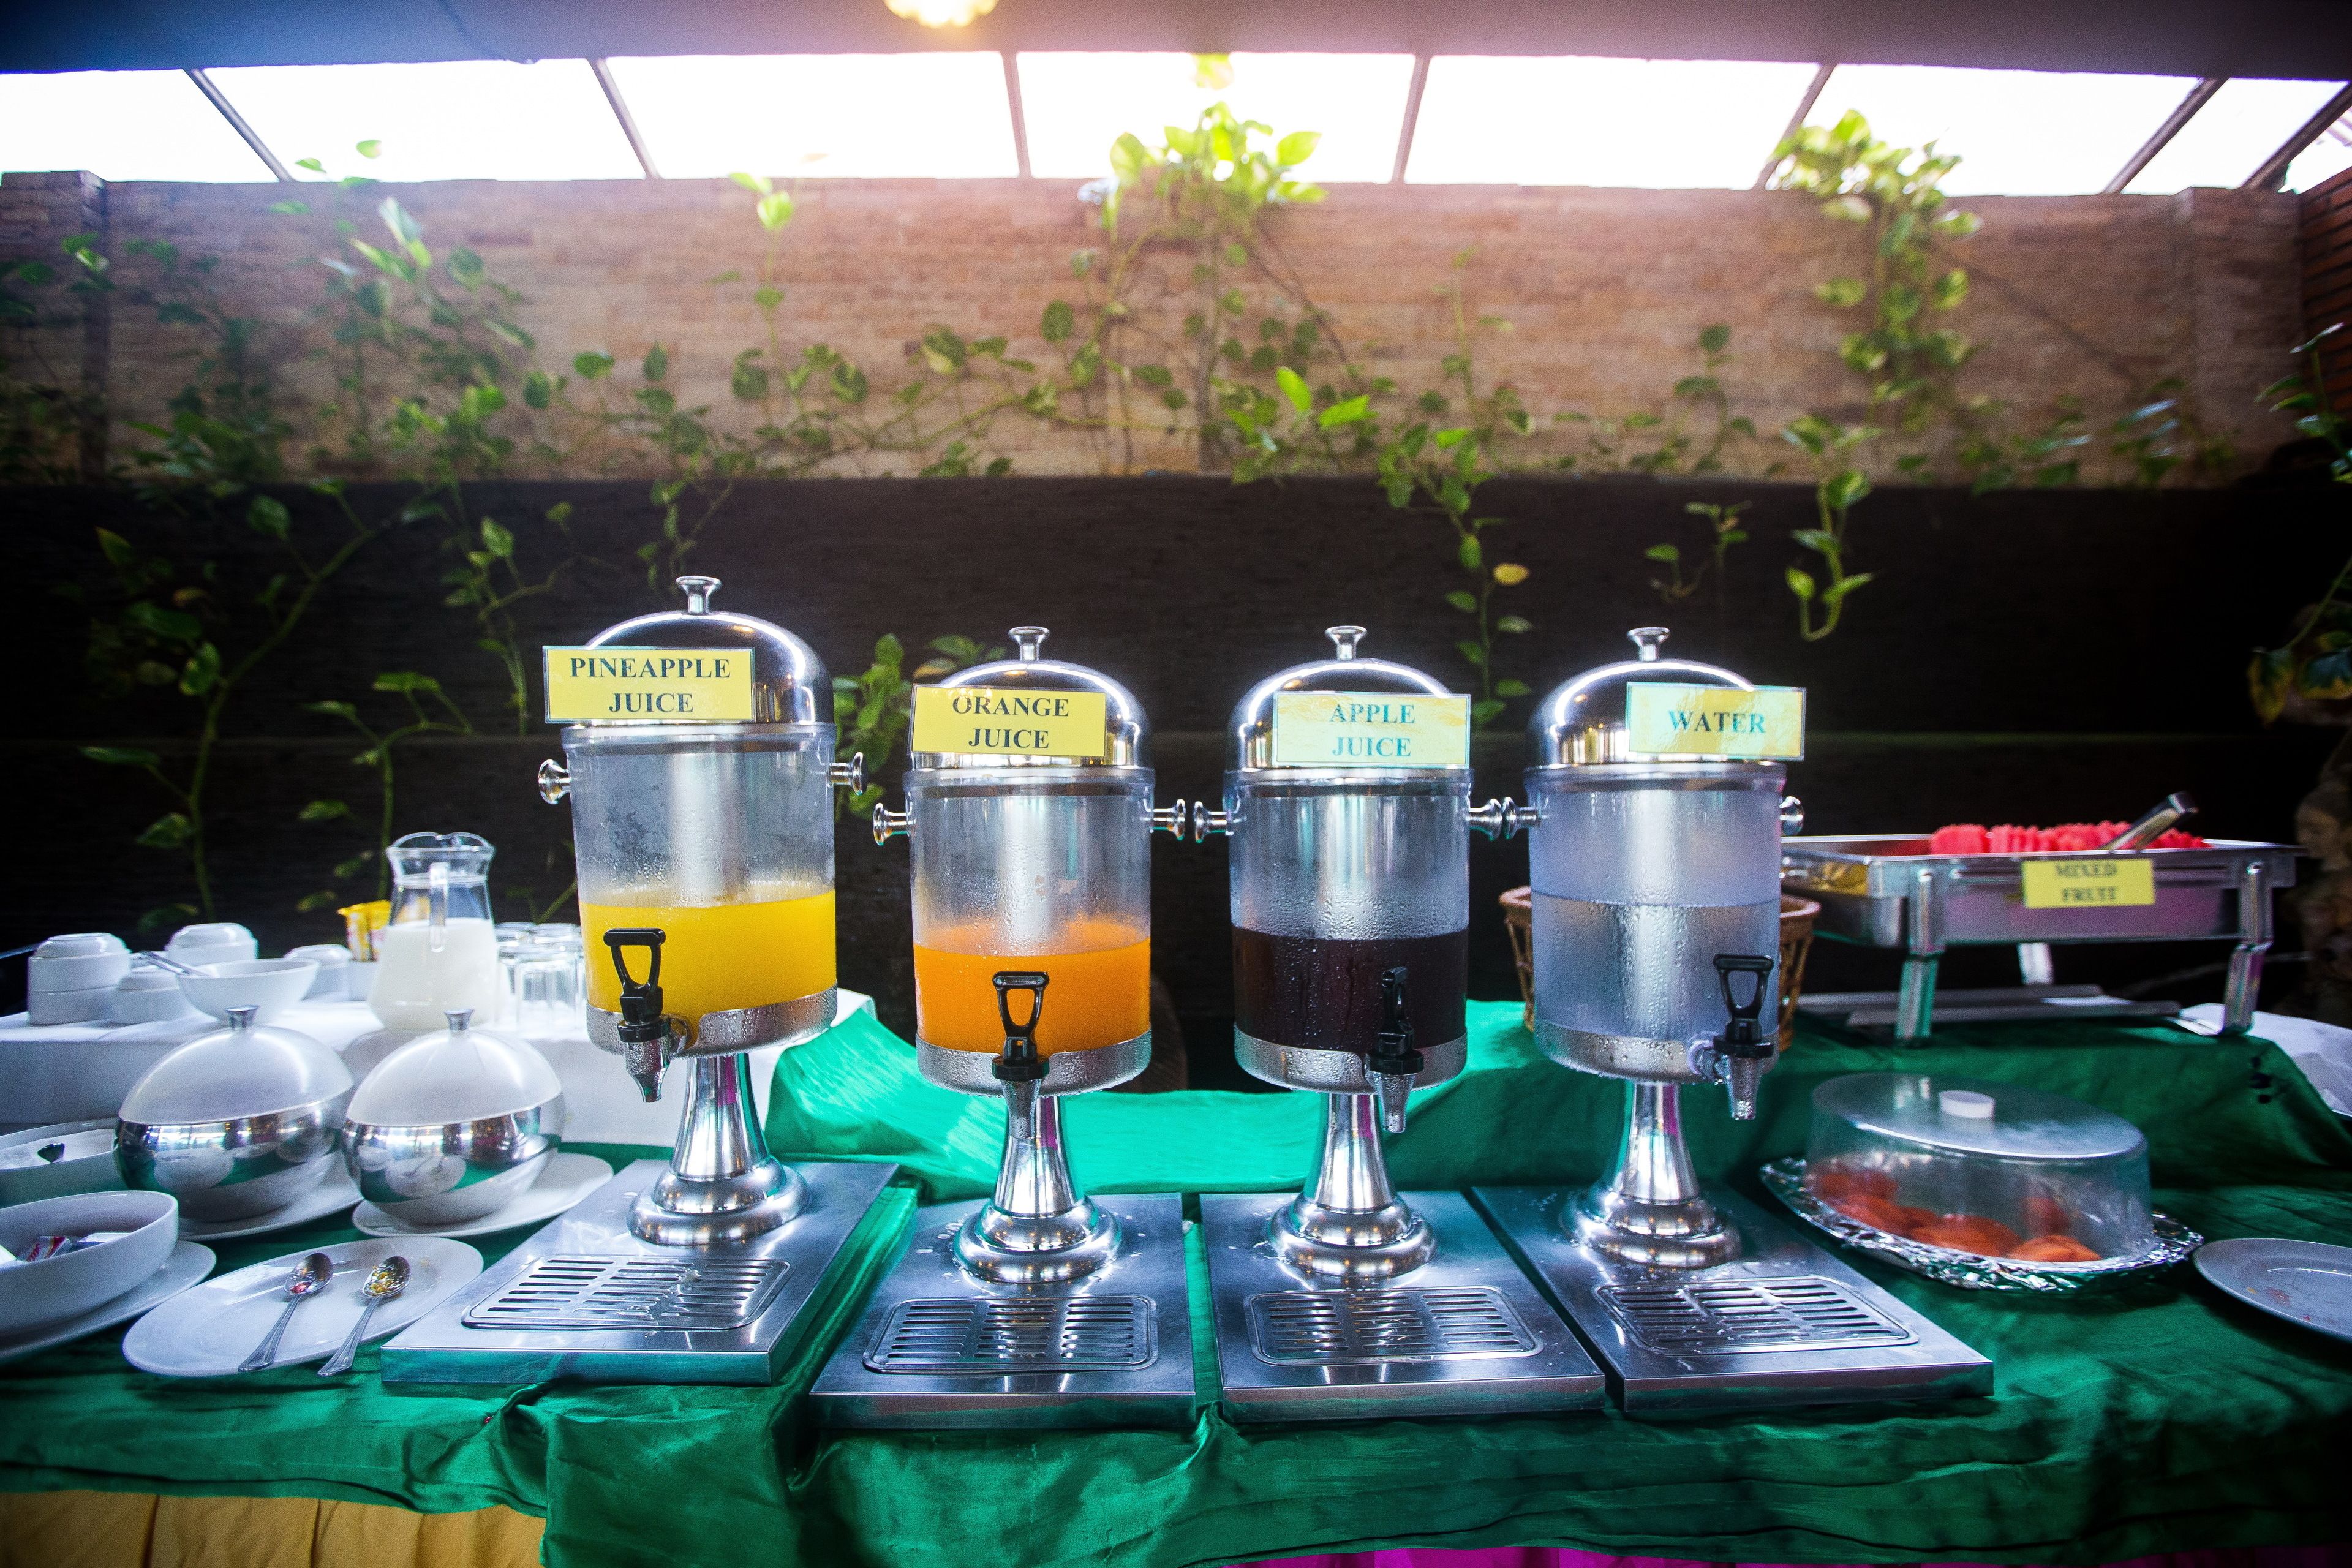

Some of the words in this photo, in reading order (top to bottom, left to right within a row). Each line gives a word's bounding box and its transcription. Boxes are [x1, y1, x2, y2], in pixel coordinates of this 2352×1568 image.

[570, 658, 730, 679] PINEAPPLE
[608, 693, 693, 712] JUICE
[952, 696, 1069, 717] ORANGE
[1329, 703, 1415, 723] APPLE
[1668, 710, 1765, 734] WATER
[968, 728, 1049, 748] JUICE
[1332, 737, 1411, 757] JUICE
[2062, 886, 2118, 902] FRUIT
